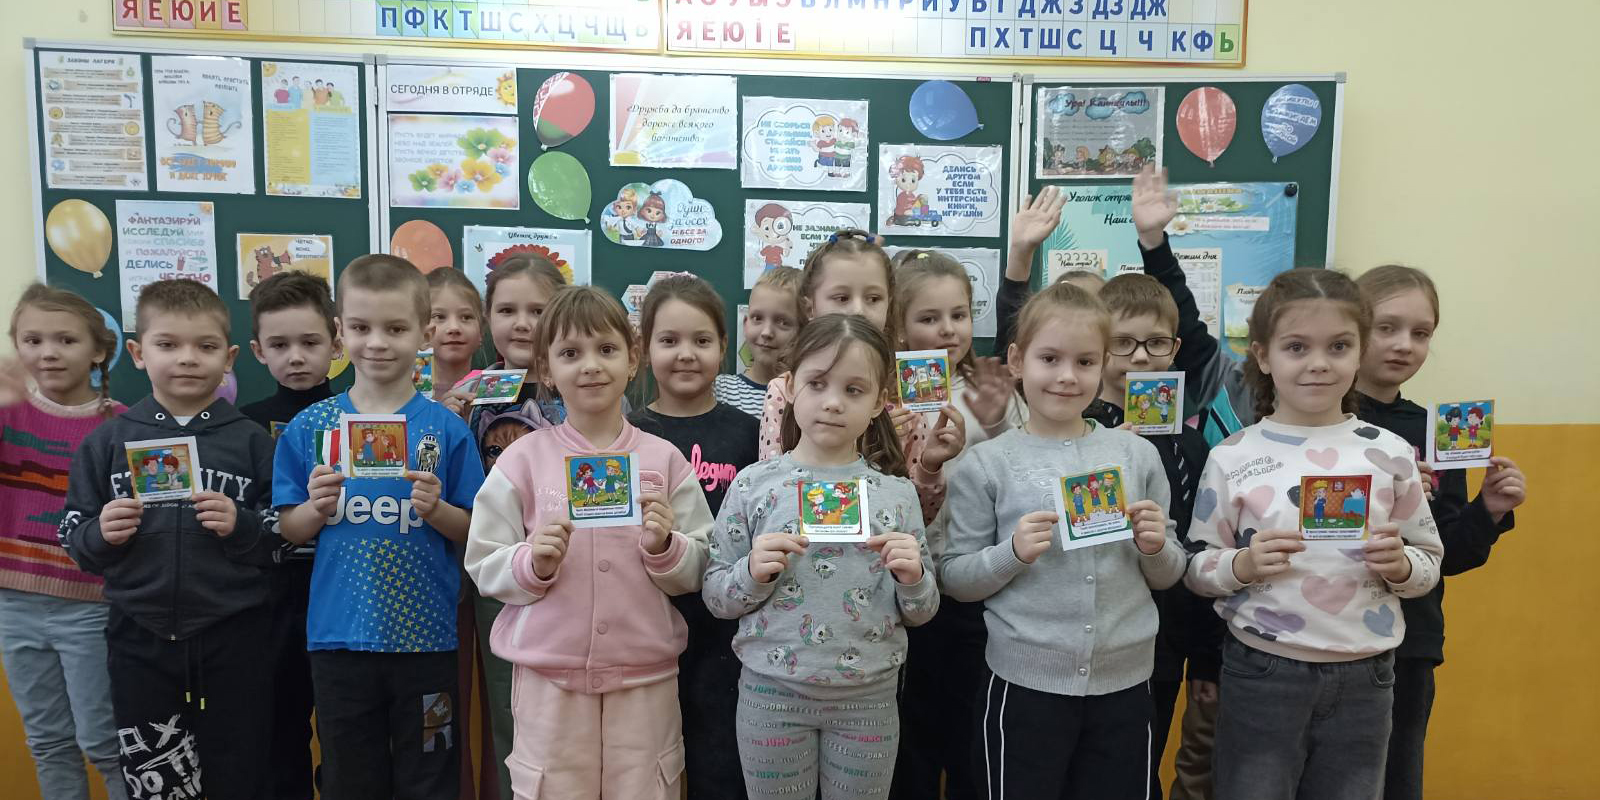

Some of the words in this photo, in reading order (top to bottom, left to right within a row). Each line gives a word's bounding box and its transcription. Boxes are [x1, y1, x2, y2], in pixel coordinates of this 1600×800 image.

[390, 84, 439, 95] СЕГОДНЯ
[443, 86, 449, 94] В
[452, 86, 493, 96] ОТРЯДЕ
[672, 104, 682, 113] да
[684, 104, 730, 116] братство
[943, 165, 976, 173] ДЕЛИСЬ
[1067, 191, 1102, 202] Уголок
[677, 201, 704, 217] Один
[947, 203, 978, 211] КНИГИ,
[128, 215, 201, 225] ФАНТАЗИРУЙ
[1104, 213, 1127, 225] Наш
[122, 226, 184, 236] ИССЛЕДУЙ
[125, 260, 174, 269] ДЕЛИСЬ
[326, 486, 424, 534] Jeep
